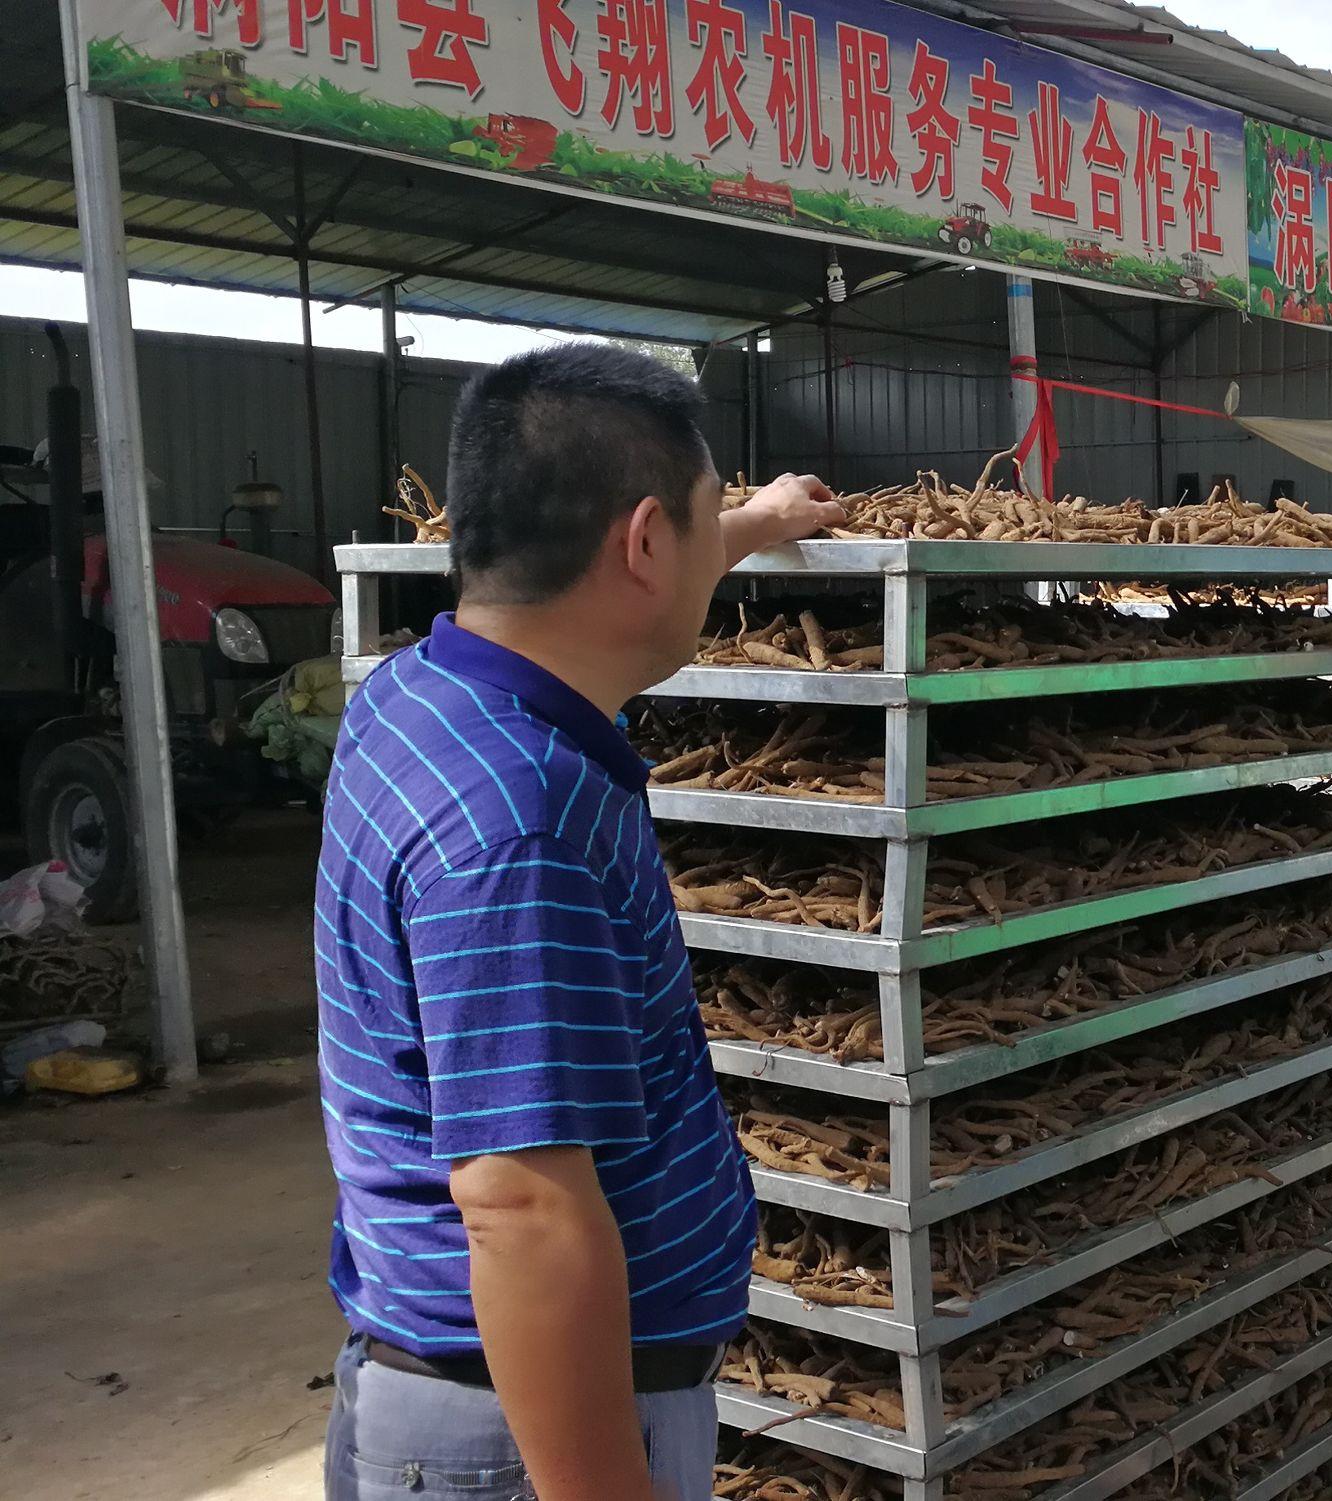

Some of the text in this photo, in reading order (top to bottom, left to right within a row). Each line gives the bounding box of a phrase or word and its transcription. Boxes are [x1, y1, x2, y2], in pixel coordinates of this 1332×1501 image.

[159, 0, 1223, 254] 县飞翔农机服务专业合作社
